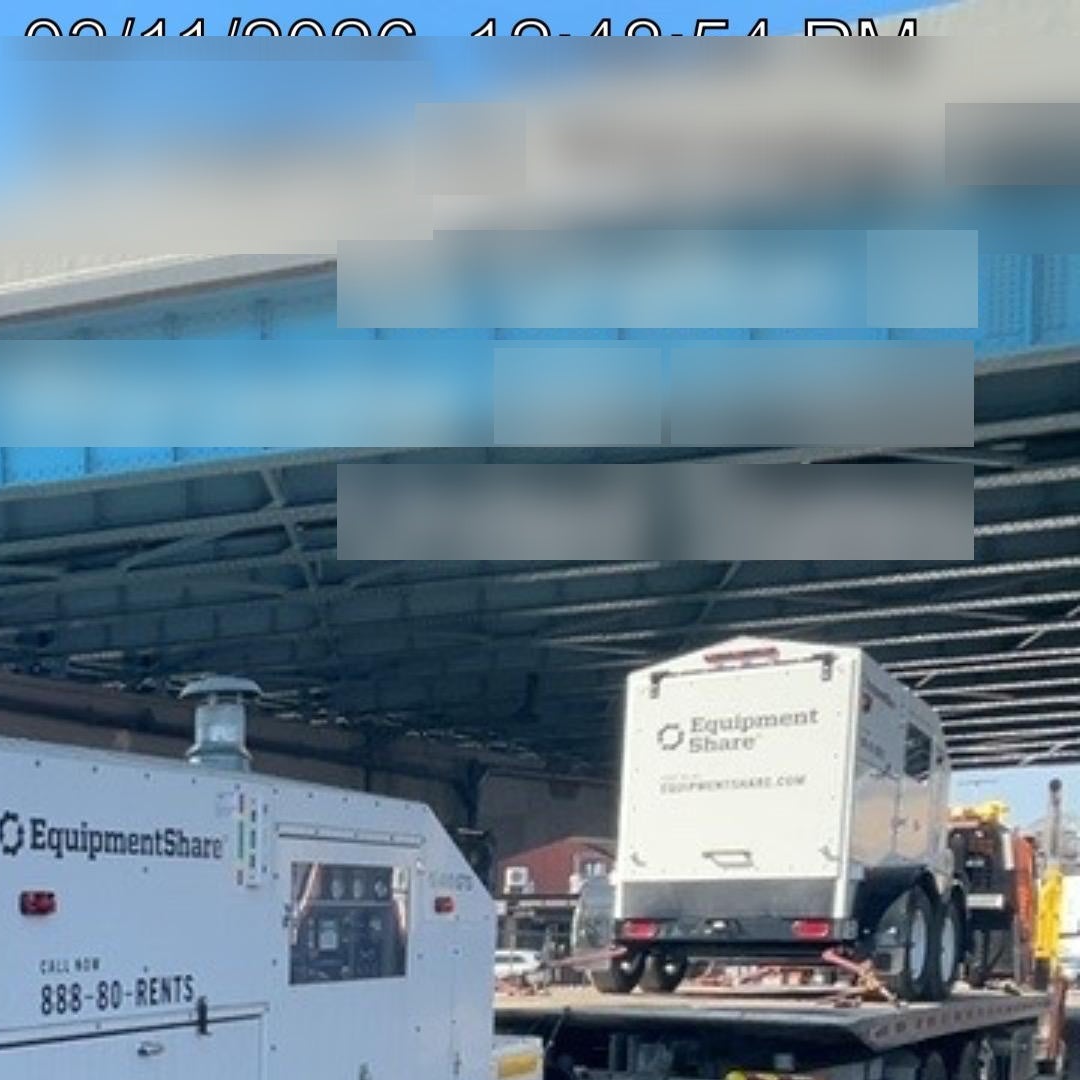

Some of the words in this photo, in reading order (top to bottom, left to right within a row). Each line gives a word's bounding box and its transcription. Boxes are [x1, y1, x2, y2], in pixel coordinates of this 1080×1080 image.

[689, 709, 820, 735] Equipment
[689, 737, 756, 754] Share
[29, 817, 222, 861] EquipmentShare
[39, 958, 70, 975] CALL
[39, 973, 196, 1016] 888-80-RENTS
